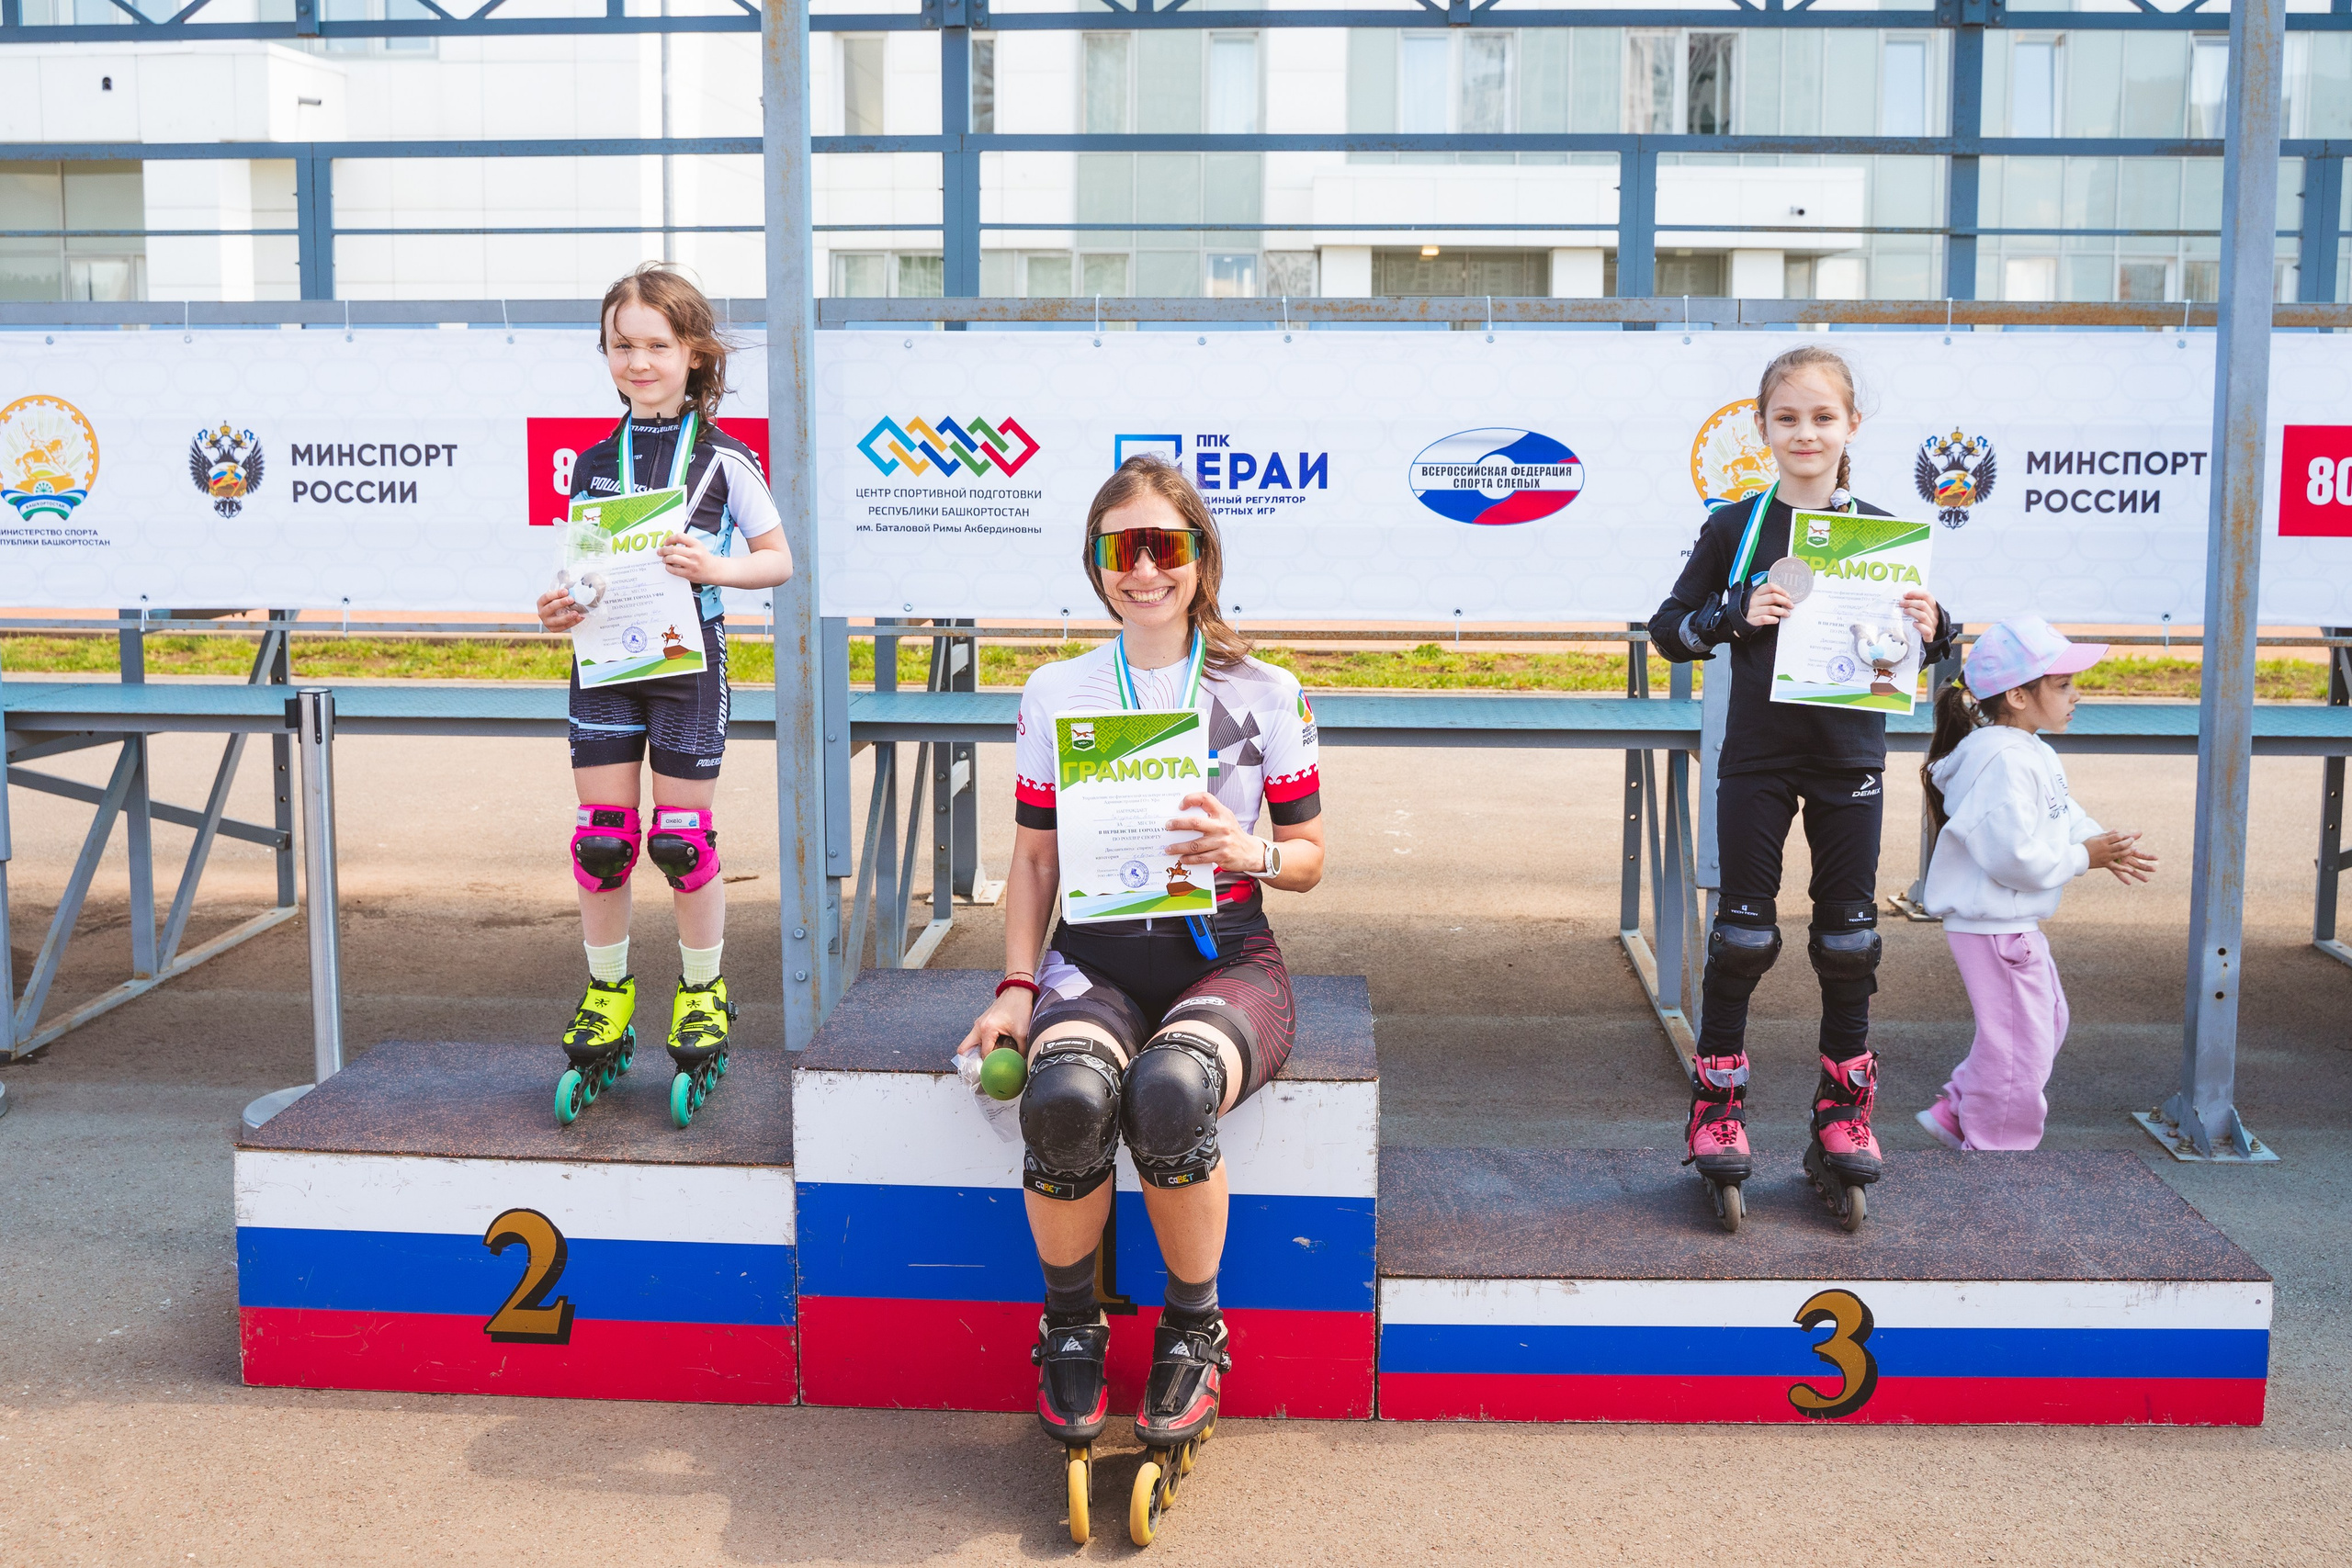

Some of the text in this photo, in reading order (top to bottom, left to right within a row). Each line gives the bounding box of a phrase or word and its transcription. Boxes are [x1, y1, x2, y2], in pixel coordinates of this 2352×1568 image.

[1196, 434, 1230, 447] ППК
[291, 444, 458, 467] МИНСПОРТ
[2026, 451, 2208, 475] МИНСПОРТ
[1196, 452, 1329, 490] ЕРАИ
[1421, 464, 1572, 478] ВСЕРОССИЙСКАЯ ФЕДЕРАЦИЯ
[293, 480, 417, 503] РОССИИ
[1453, 478, 1541, 489] СПОРТА СЛЕПЫХ
[855, 488, 1042, 500] ЦЕНТР СПОРТИВНОЙ ПОДГОТОВКИ
[1204, 495, 1306, 504] ДИНЫЙ РЕГУЛЯТОР
[2025, 489, 2160, 513] РОССИИ
[868, 506, 1030, 517] РЕСПУБЛИКИ БАШКОРТОСТАН
[1211, 507, 1275, 515] АРТНЫХ ИГР
[856, 523, 1042, 535] им. Баталовой Римы Акбердиновны
[612, 530, 677, 555] МОТА
[695, 757, 722, 767] POWERS
[1062, 756, 1200, 784] ГРАМОТА
[1852, 787, 1881, 797] DEMIX
[482, 1207, 576, 1346] 2
[1061, 1336, 1083, 1352] K2
[1169, 1339, 1191, 1357] K2
[1788, 1288, 1878, 1419] 3
